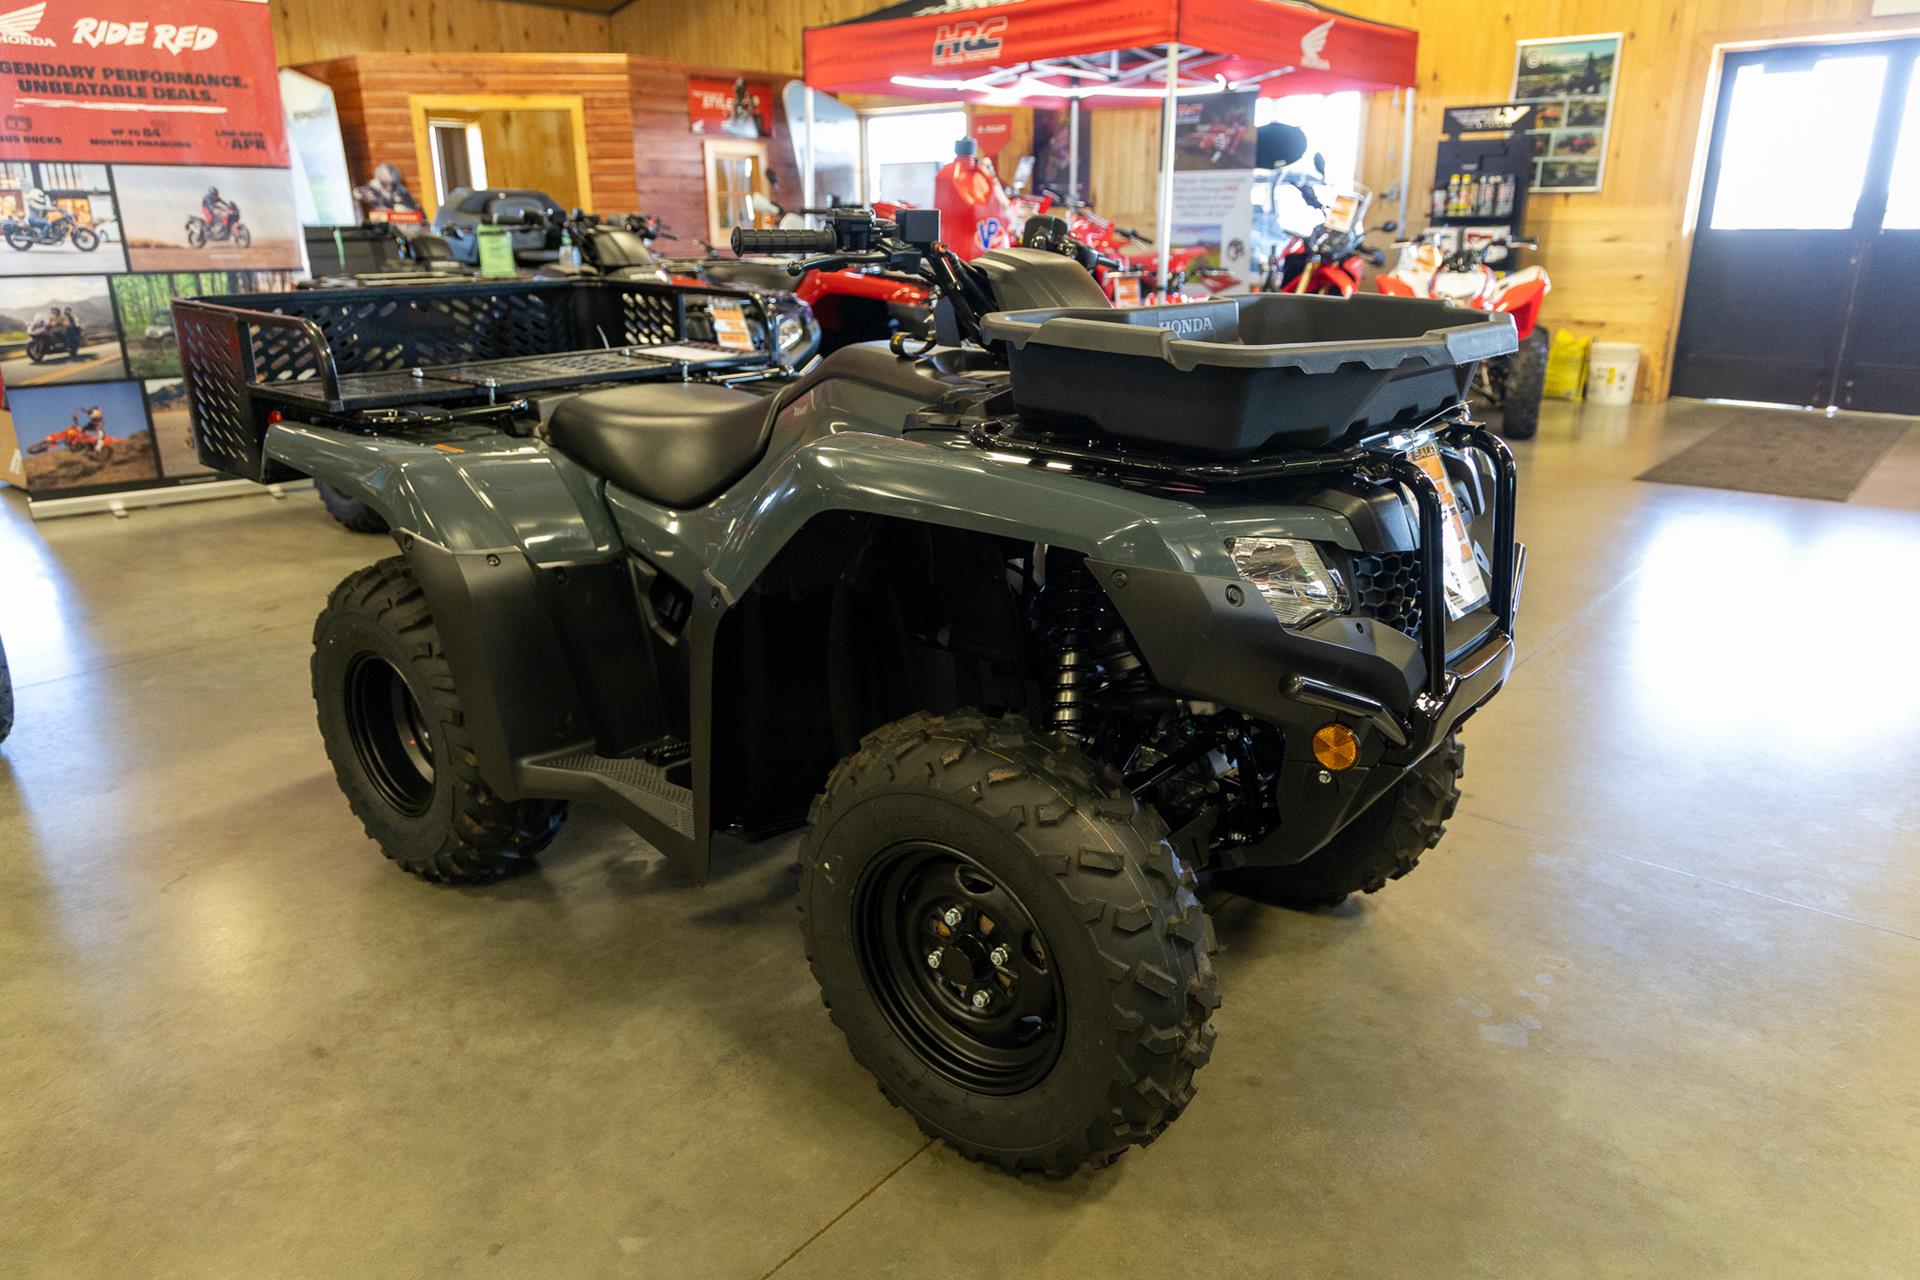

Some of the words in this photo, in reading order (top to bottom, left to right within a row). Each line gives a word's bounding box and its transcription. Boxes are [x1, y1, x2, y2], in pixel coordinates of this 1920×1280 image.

[72, 17, 149, 48] RIDE
[153, 24, 218, 56] RED
[933, 16, 1008, 58] HRC
[18, 79, 147, 98] UNBEATABLE
[153, 86, 217, 102] DEALS.
[102, 68, 248, 88] PERFORMANCE.
[977, 219, 999, 249] VP
[1159, 317, 1214, 334] HONDA
